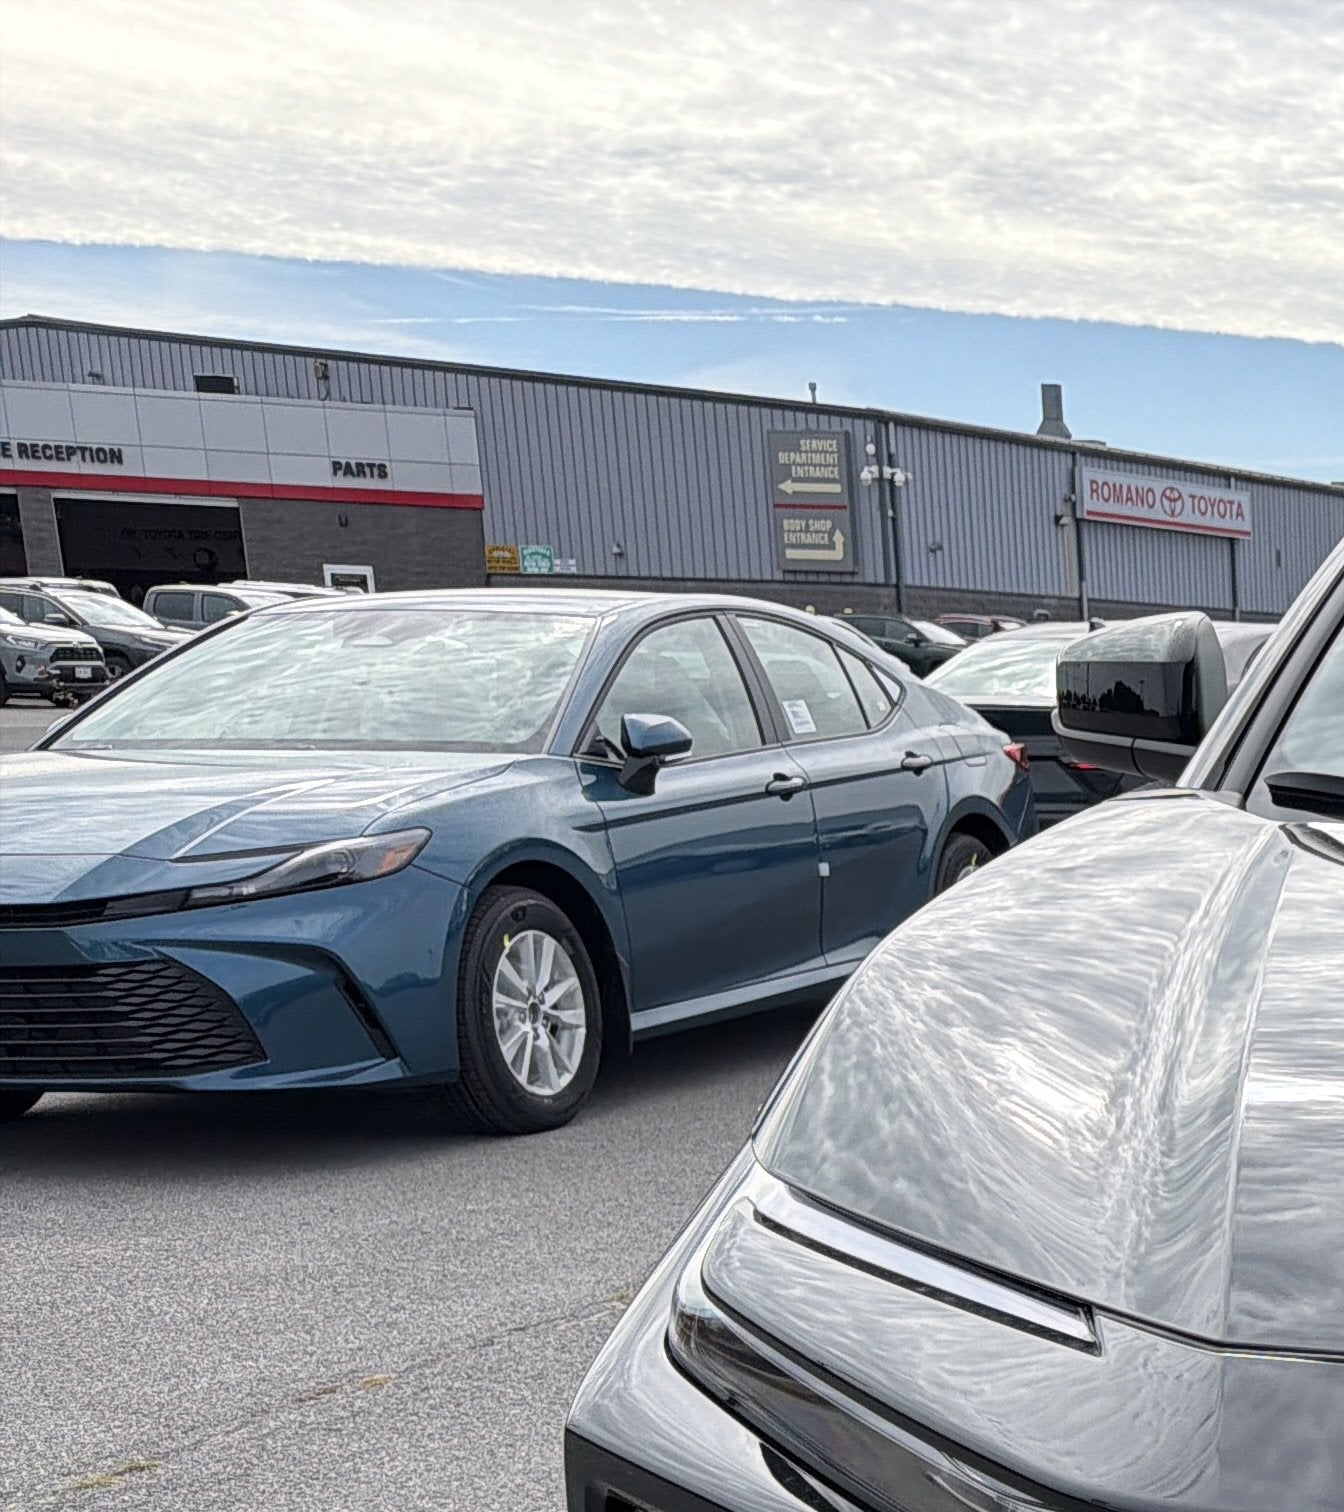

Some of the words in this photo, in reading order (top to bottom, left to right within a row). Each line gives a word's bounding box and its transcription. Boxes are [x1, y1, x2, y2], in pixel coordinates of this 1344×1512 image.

[800, 439, 838, 452] SERVICE
[16, 442, 124, 465] RECEPTION
[778, 452, 839, 465] DEPARTMENT
[332, 460, 389, 480] PARTS
[791, 465, 840, 479] ENTRANCE
[1089, 479, 1157, 509] ROMANO
[1189, 494, 1245, 522] TOYOTA
[782, 518, 806, 532] BODY
[808, 518, 832, 532] SHOP
[783, 531, 830, 545] ENTRANCE
